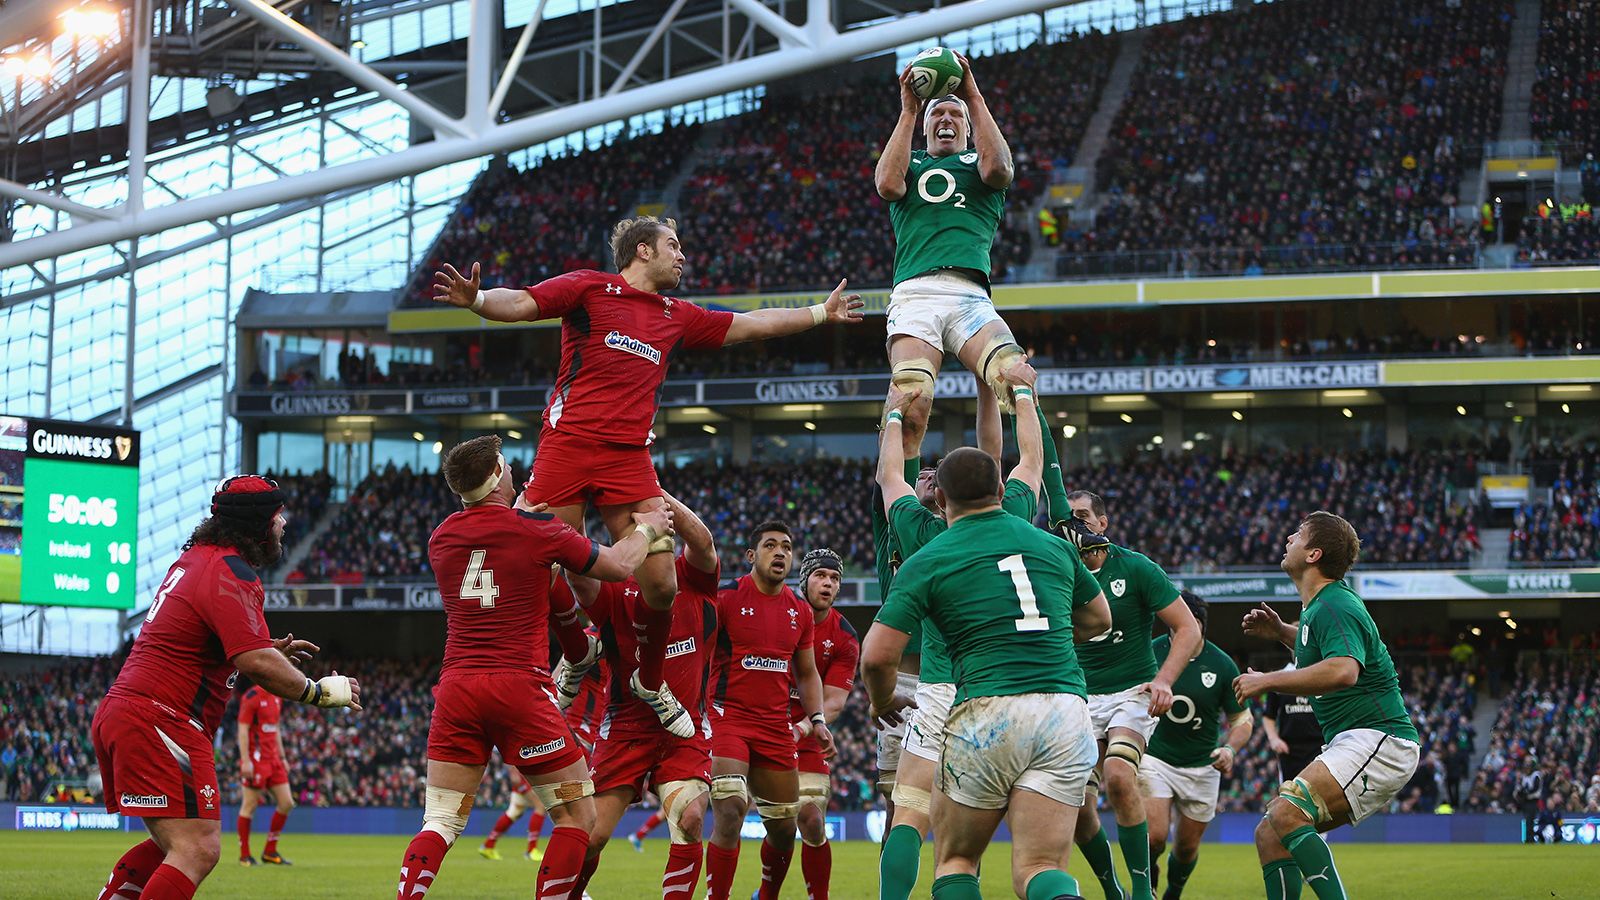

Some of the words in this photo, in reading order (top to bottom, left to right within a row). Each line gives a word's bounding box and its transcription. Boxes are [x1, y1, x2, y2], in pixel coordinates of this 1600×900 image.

[917, 168, 966, 209] O2
[620, 336, 661, 362] Admiral
[1037, 371, 1145, 393] EN+CARE
[1154, 370, 1215, 389] DOVE
[1251, 365, 1378, 386] MEN+CARE
[755, 379, 839, 402] GUINNESS
[271, 391, 350, 415] GUINNESS
[33, 429, 112, 459] GUINNESS
[48, 493, 118, 527] 50:06
[49, 540, 91, 559] Ireland
[107, 541, 131, 565] 16
[53, 573, 90, 592] Wales
[105, 571, 120, 594] 0
[460, 549, 499, 609] 4
[1507, 574, 1571, 590] EVENTS
[997, 553, 1050, 632] 1
[666, 638, 695, 655] miral
[755, 657, 787, 670] Admira
[1166, 694, 1201, 730] O2
[530, 737, 565, 755] Admiral
[130, 795, 167, 806] Admiral
